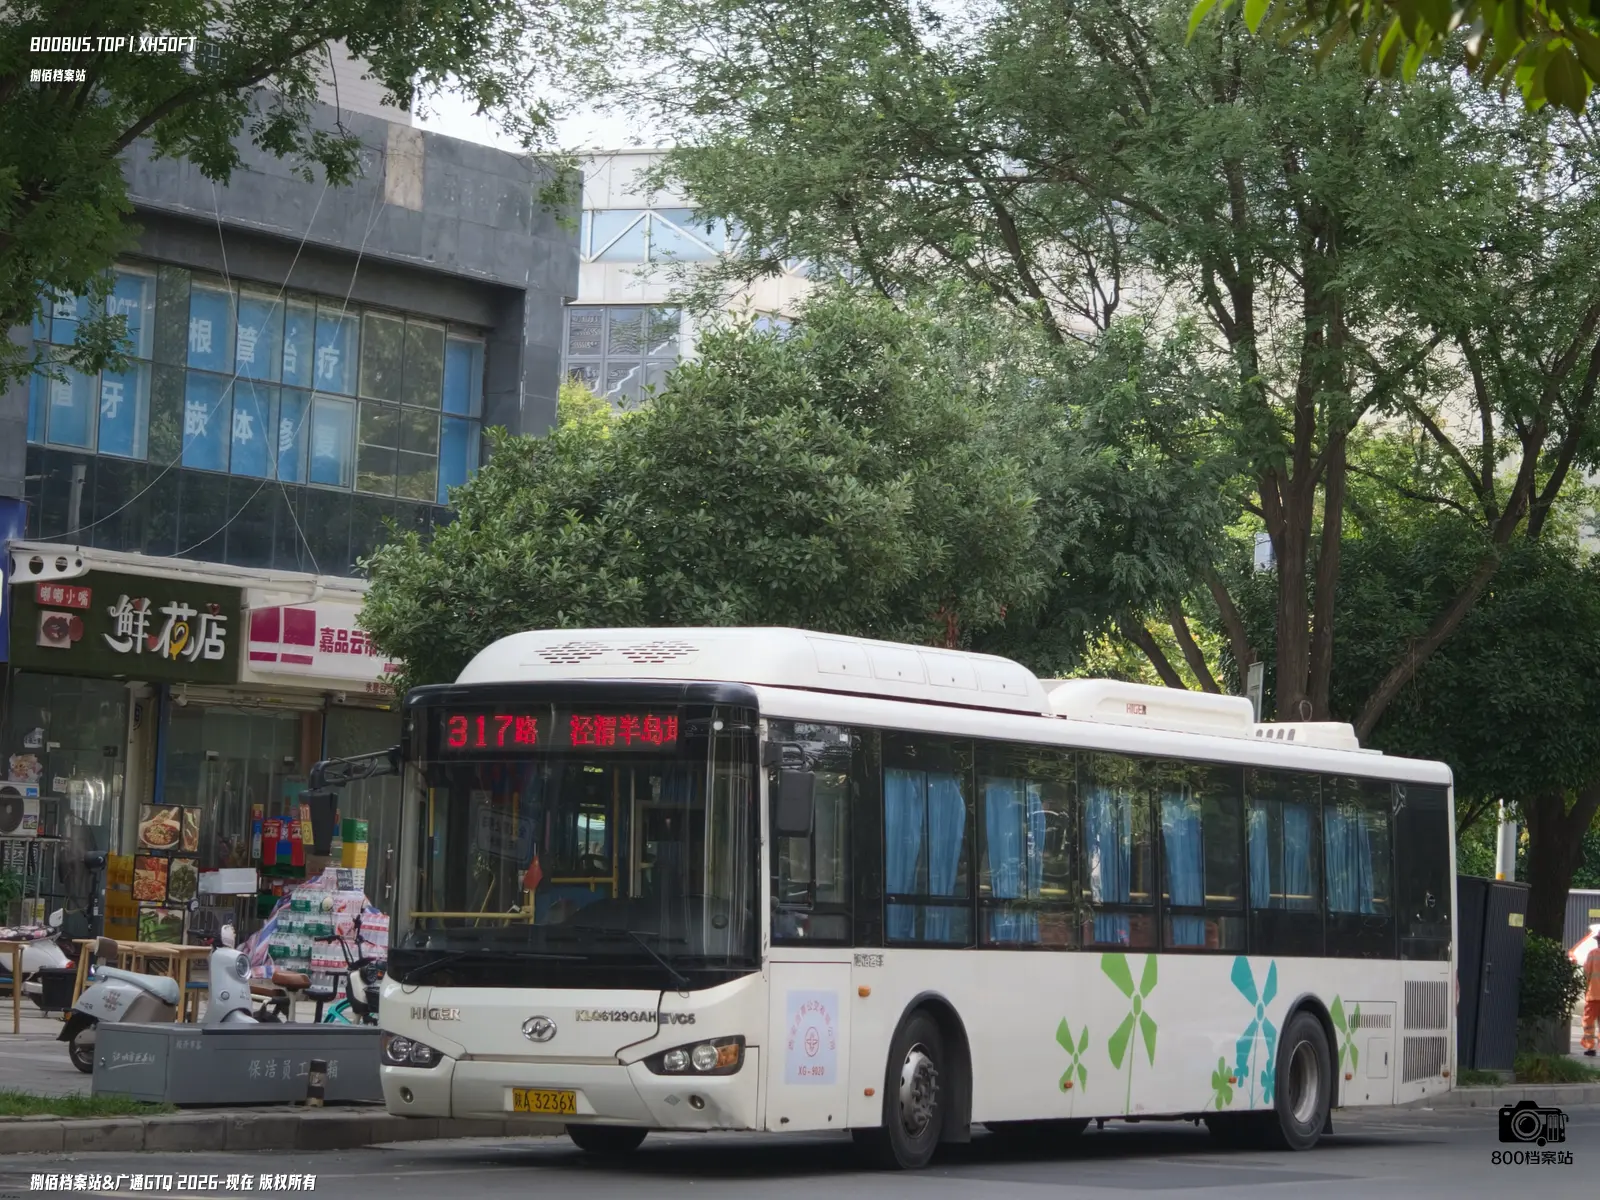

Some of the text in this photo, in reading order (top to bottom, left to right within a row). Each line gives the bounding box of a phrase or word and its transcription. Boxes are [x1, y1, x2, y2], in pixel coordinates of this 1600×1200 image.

[102, 594, 228, 663] 鲜花店
[449, 715, 538, 747] 317路
[410, 1006, 461, 1021] HIGER
[248, 1059, 339, 1080] 保洁员工箱
